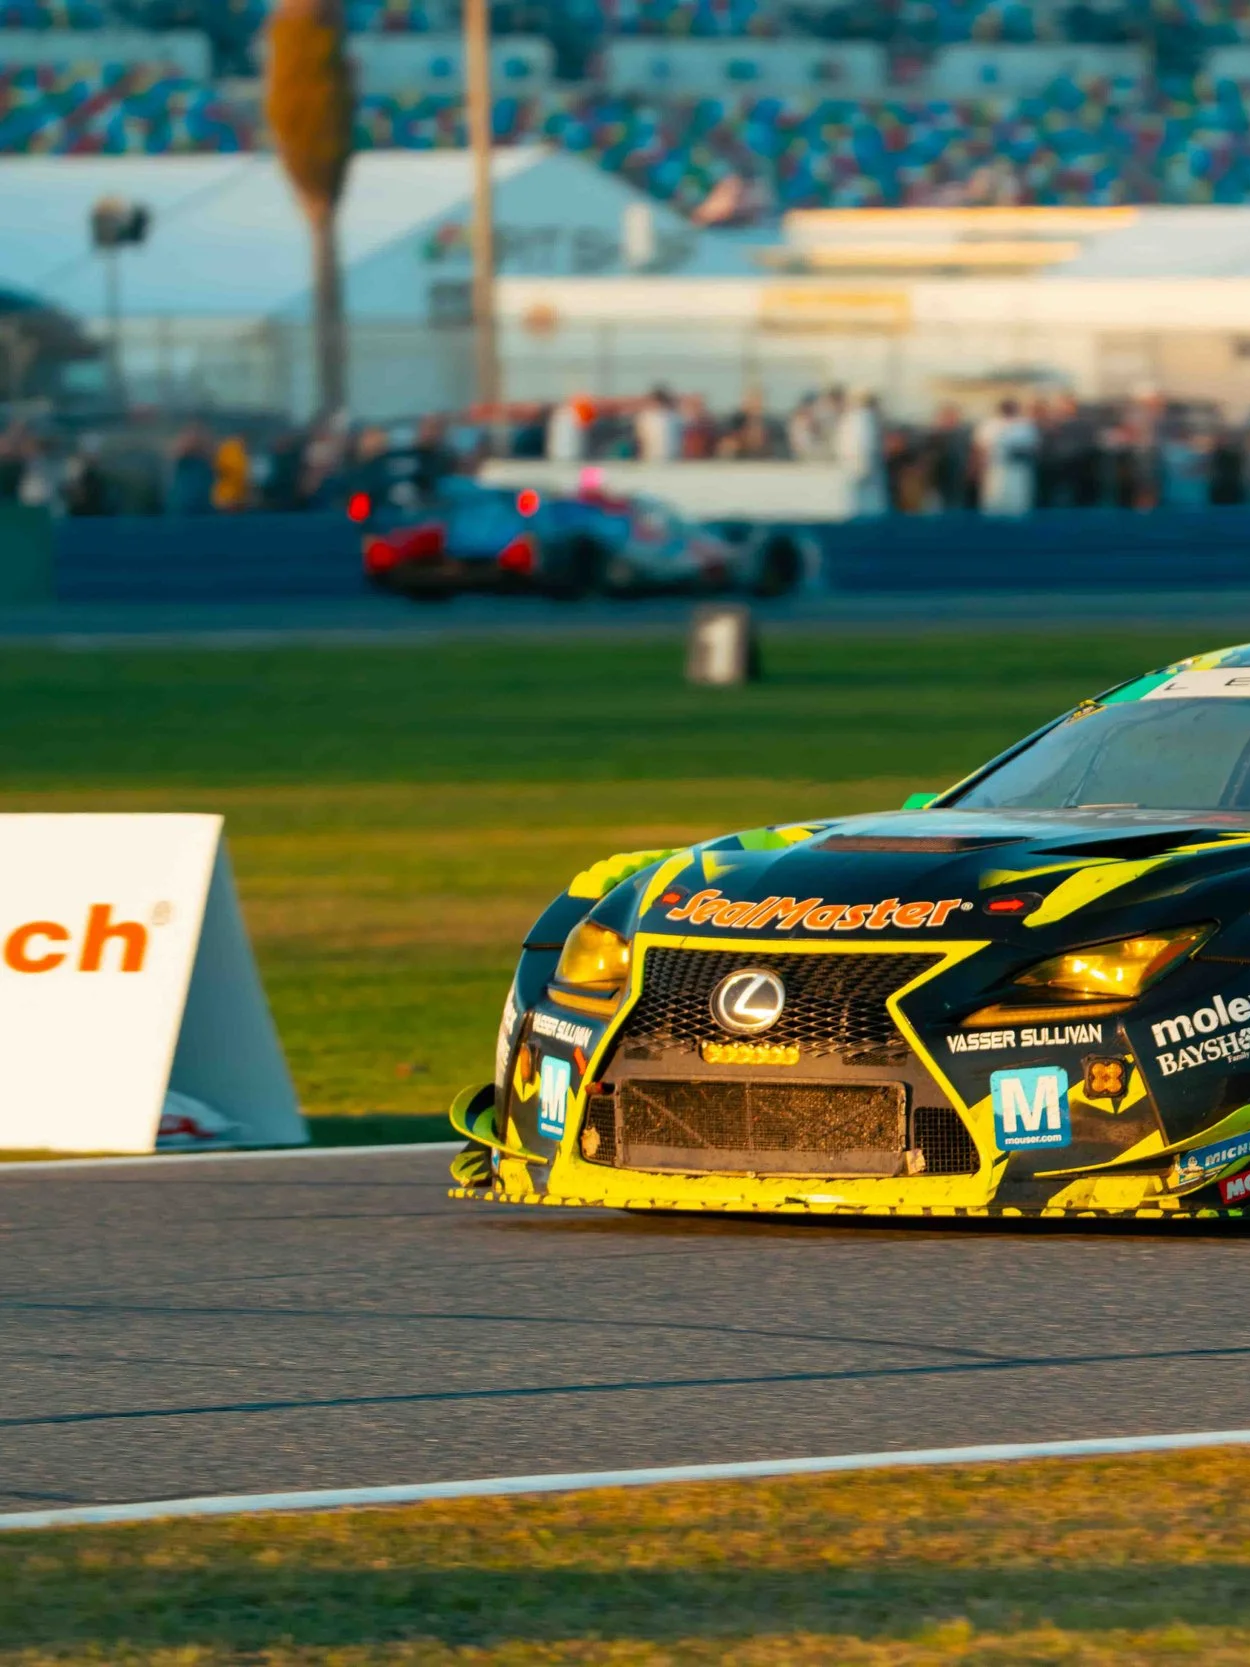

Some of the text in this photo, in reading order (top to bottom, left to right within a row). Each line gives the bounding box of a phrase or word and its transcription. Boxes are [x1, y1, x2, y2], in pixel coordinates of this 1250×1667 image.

[947, 1024, 1102, 1054] VASSER SULLIVAN
[540, 1064, 567, 1123] M
[1001, 1076, 1061, 1132] M
[1005, 1134, 1062, 1145] mouser.com
